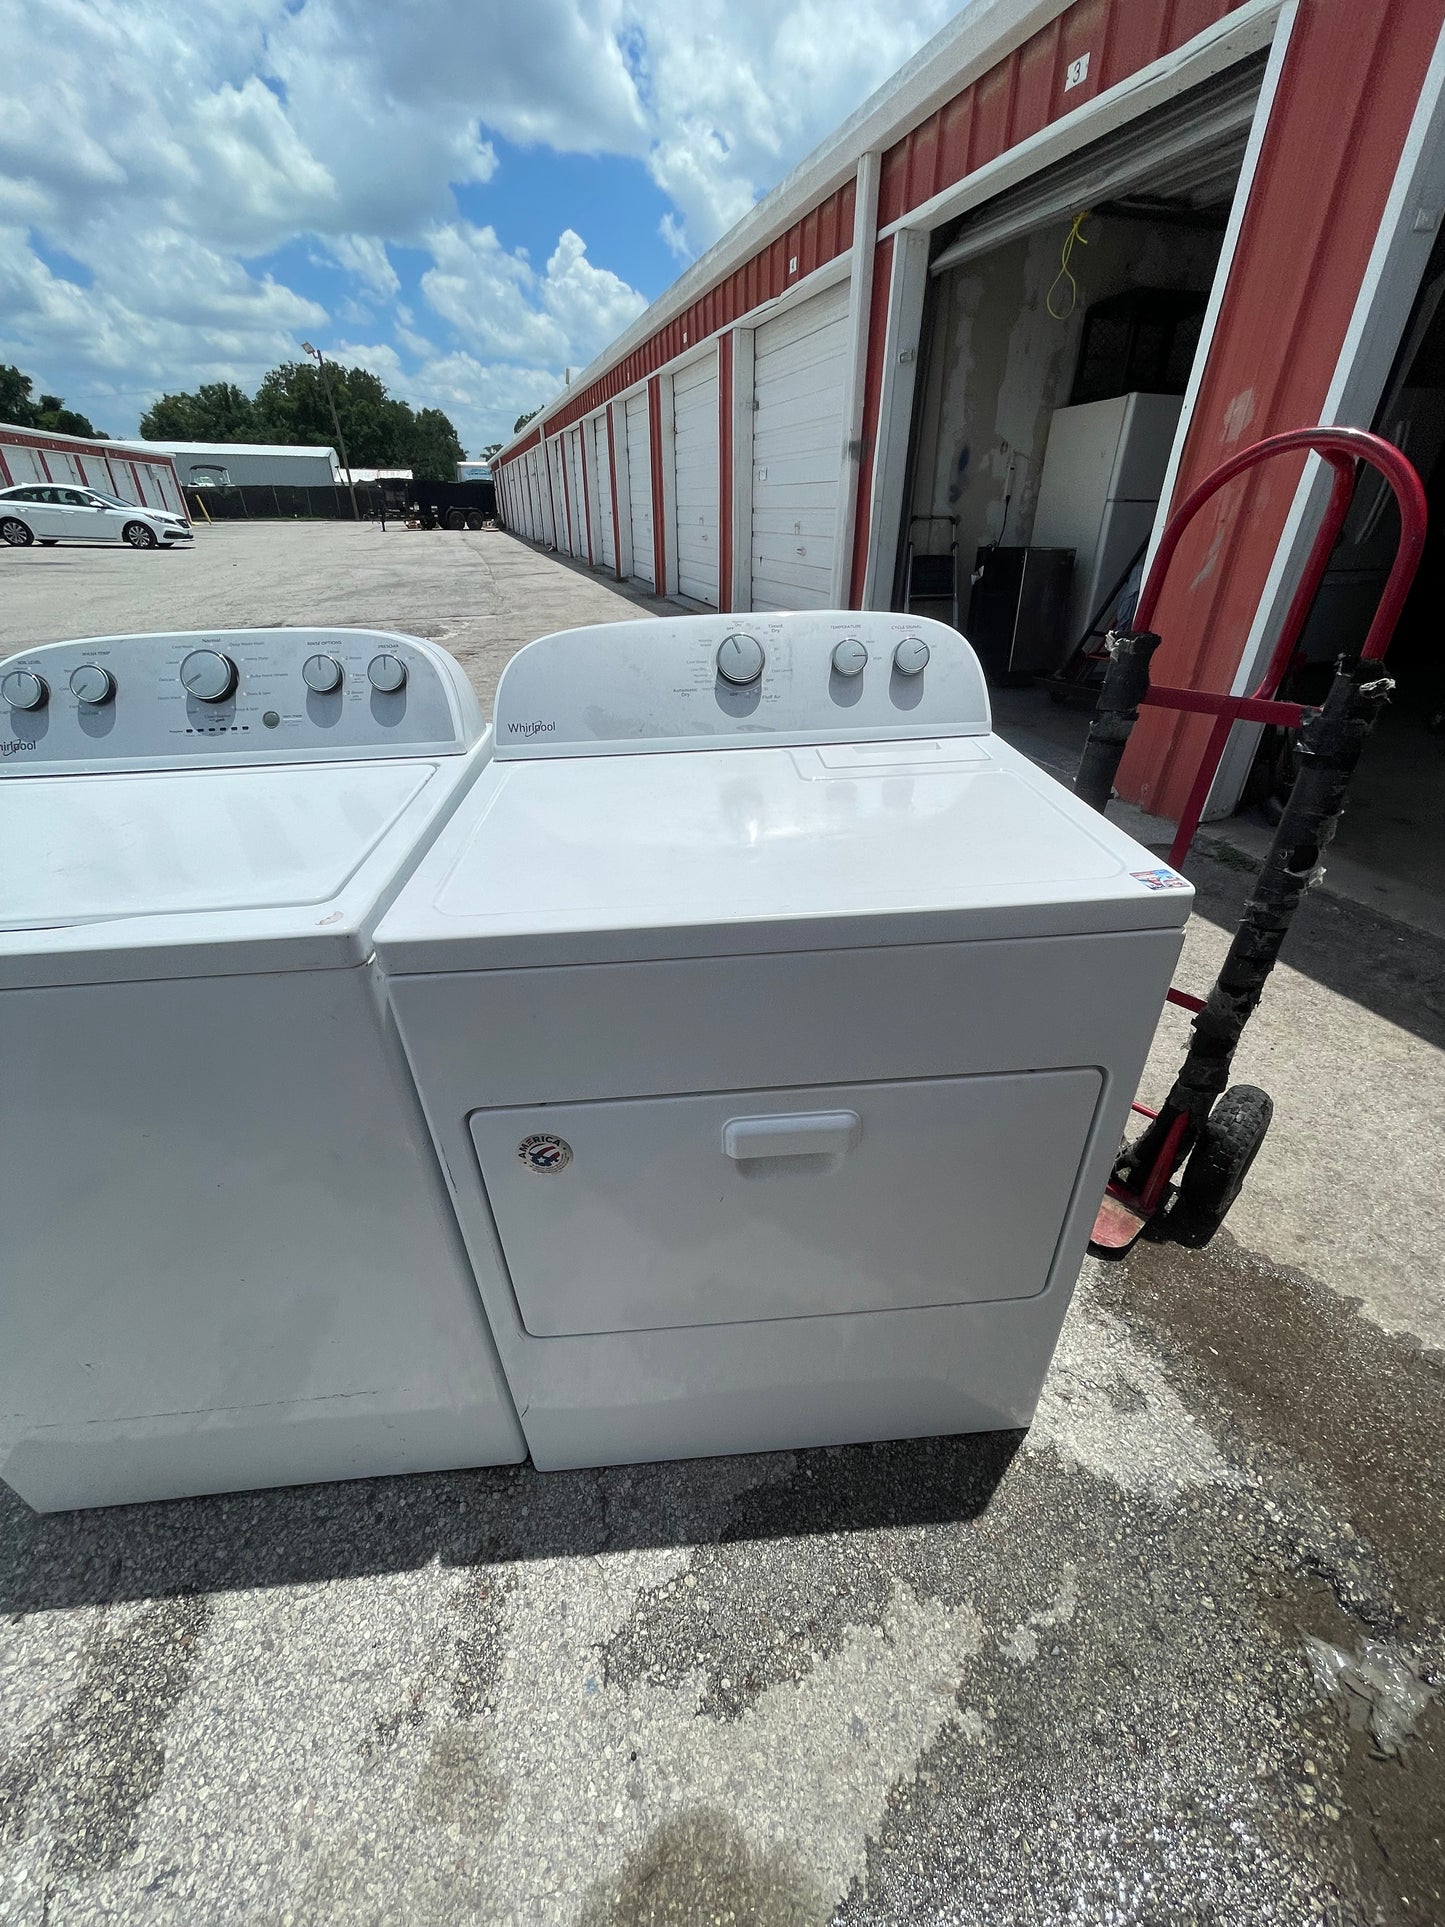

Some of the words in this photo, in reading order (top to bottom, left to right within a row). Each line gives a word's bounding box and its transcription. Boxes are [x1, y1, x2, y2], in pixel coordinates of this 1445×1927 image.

[1072, 60, 1082, 84] 3
[508, 720, 556, 738] Whirlpool
[518, 1135, 561, 1159] AMERICA
